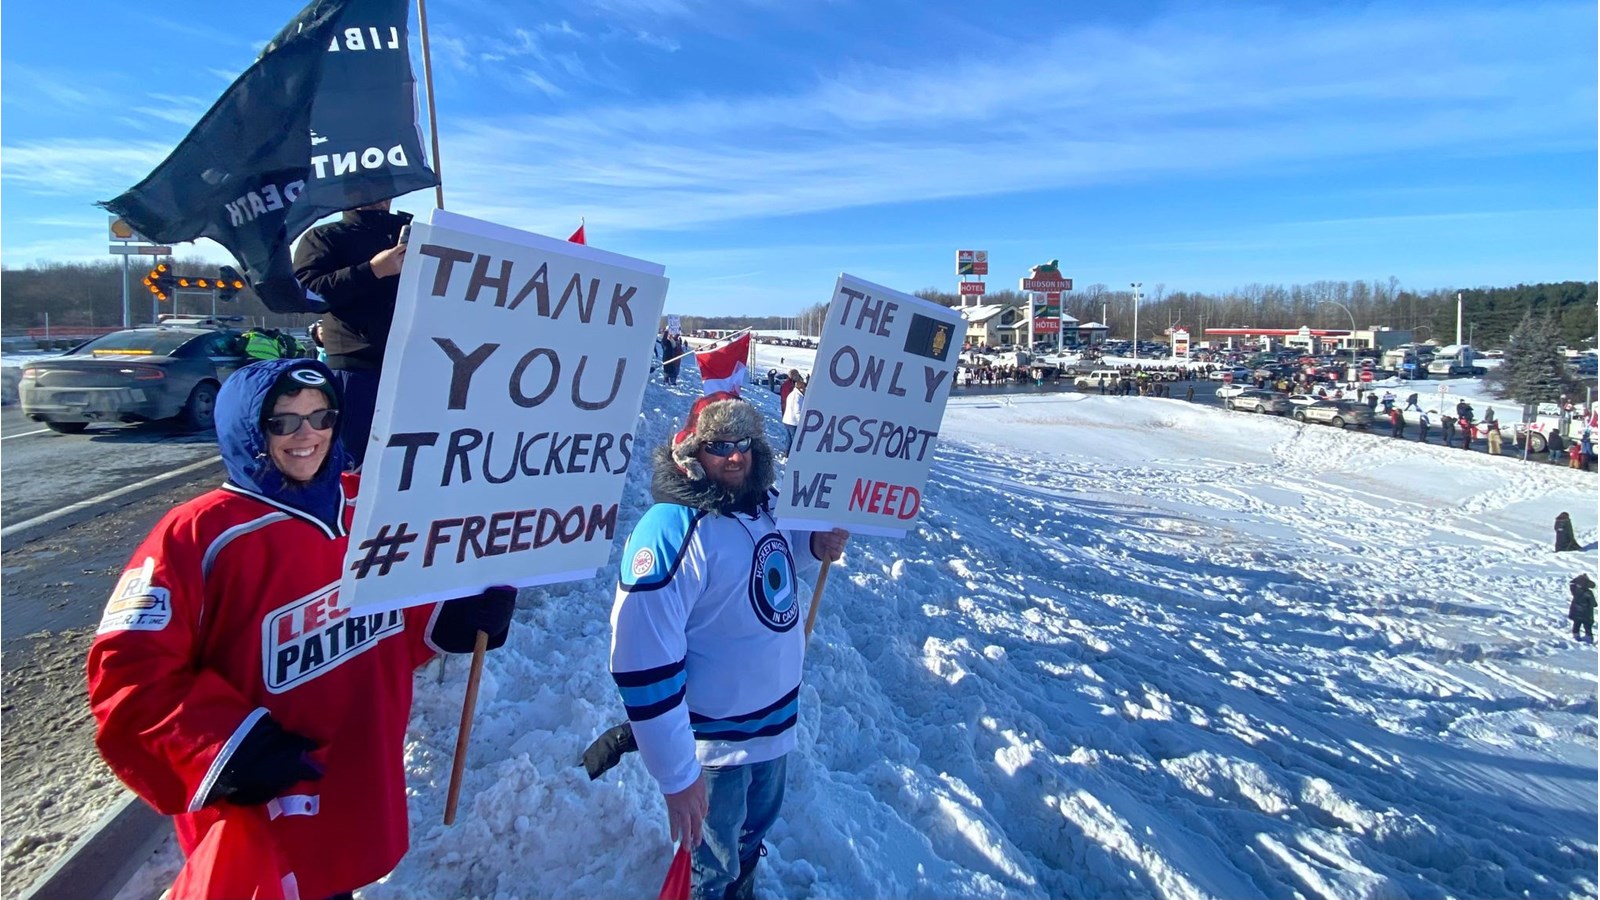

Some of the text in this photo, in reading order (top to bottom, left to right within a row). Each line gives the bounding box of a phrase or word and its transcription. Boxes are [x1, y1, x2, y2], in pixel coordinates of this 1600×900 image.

[420, 244, 638, 326] THANK
[840, 286, 899, 338] THE
[432, 337, 626, 410] YOU
[829, 345, 949, 403] ONLY
[387, 428, 634, 491] TRUCKERS
[796, 409, 939, 462] PASSPORT
[791, 470, 921, 520] WE NEED
[350, 503, 619, 579] #FREEDOM
[756, 544, 771, 578] HOCKEY
[772, 611, 781, 623] IN
